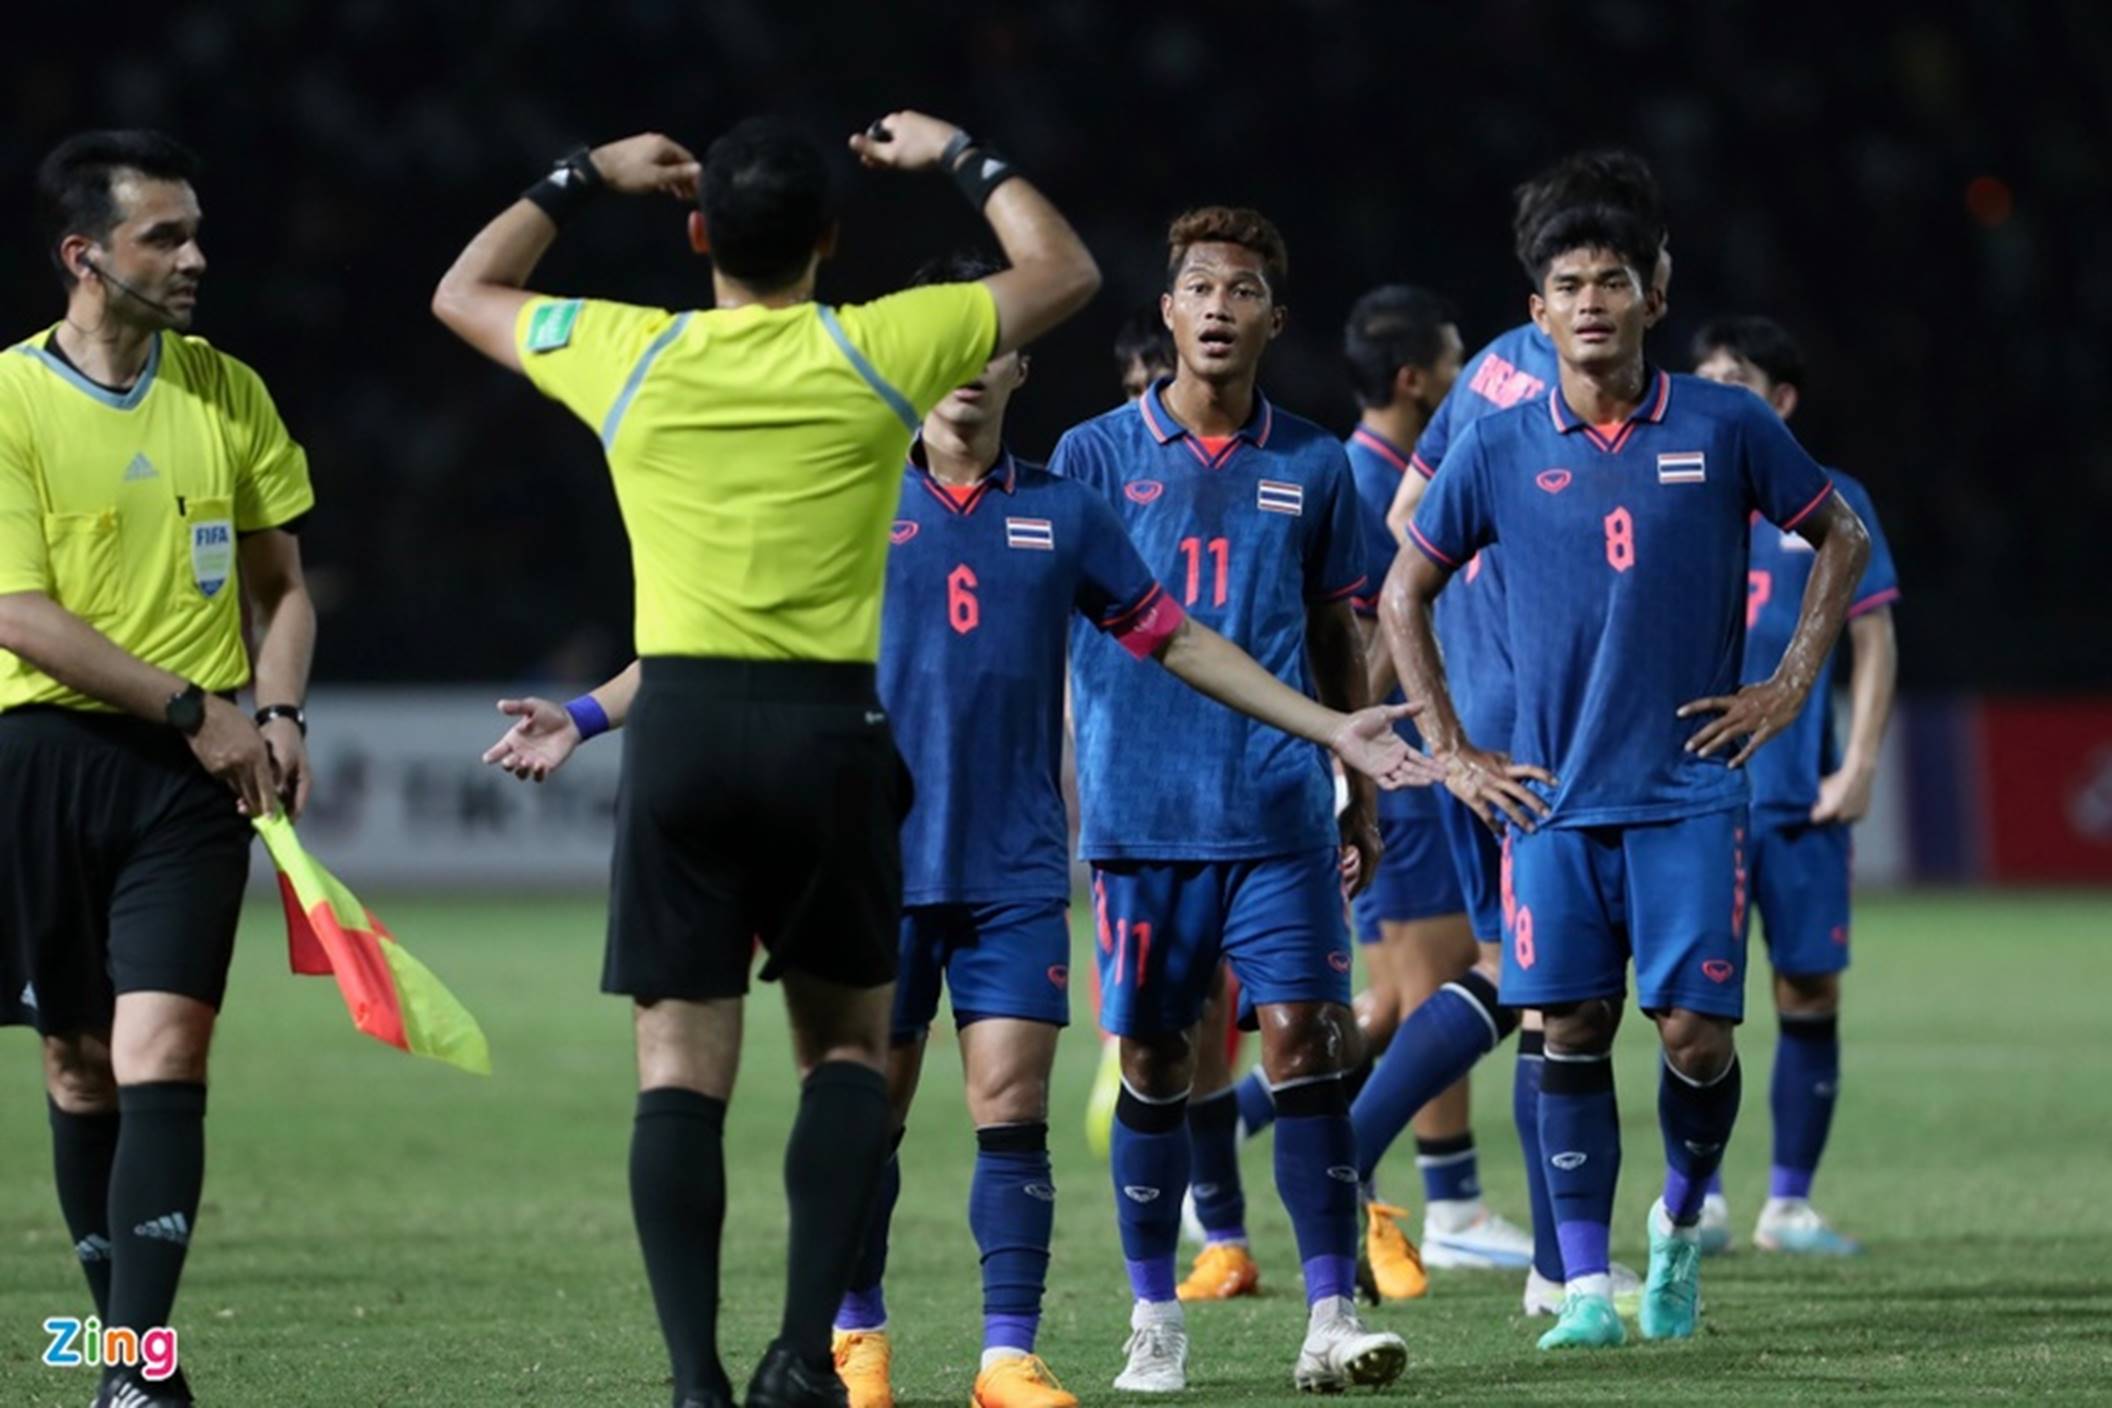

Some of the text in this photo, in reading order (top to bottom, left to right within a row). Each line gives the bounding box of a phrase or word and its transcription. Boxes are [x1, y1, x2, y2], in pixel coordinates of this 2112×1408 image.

[195, 525, 230, 547] FIFA
[1603, 506, 1636, 573] 8
[946, 563, 980, 636] 6
[1180, 537, 1230, 607] 11
[1114, 917, 1152, 988] 11
[1514, 905, 1536, 971] 8
